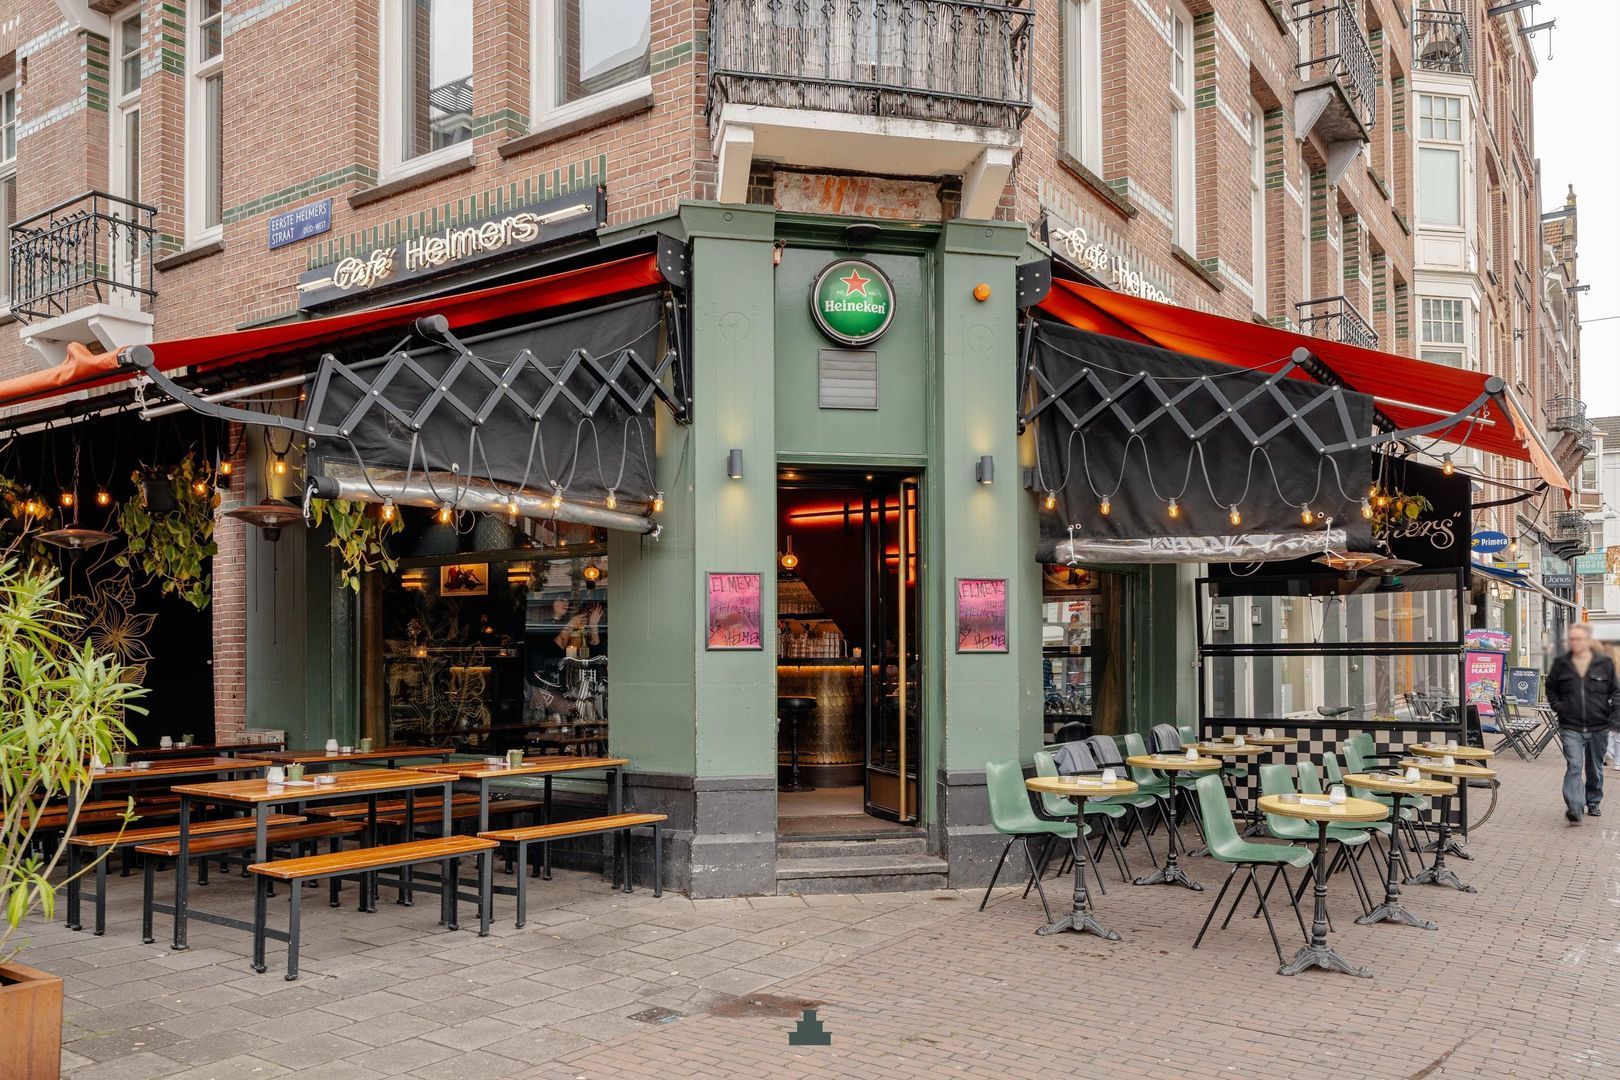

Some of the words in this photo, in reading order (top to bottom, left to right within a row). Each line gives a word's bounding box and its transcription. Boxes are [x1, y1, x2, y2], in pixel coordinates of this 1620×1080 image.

[271, 214, 294, 232] EERSTE
[295, 203, 327, 223] HELMERS
[271, 227, 295, 245] STRAAT
[334, 246, 397, 289] Café
[406, 213, 539, 272] Helmers
[1064, 227, 1108, 271] Café
[824, 299, 886, 314] Heineken
[1481, 537, 1508, 547] Primera
[1578, 560, 1606, 570] HOSTE
[710, 575, 760, 594] ELMERS
[959, 581, 1005, 599] ELMERS
